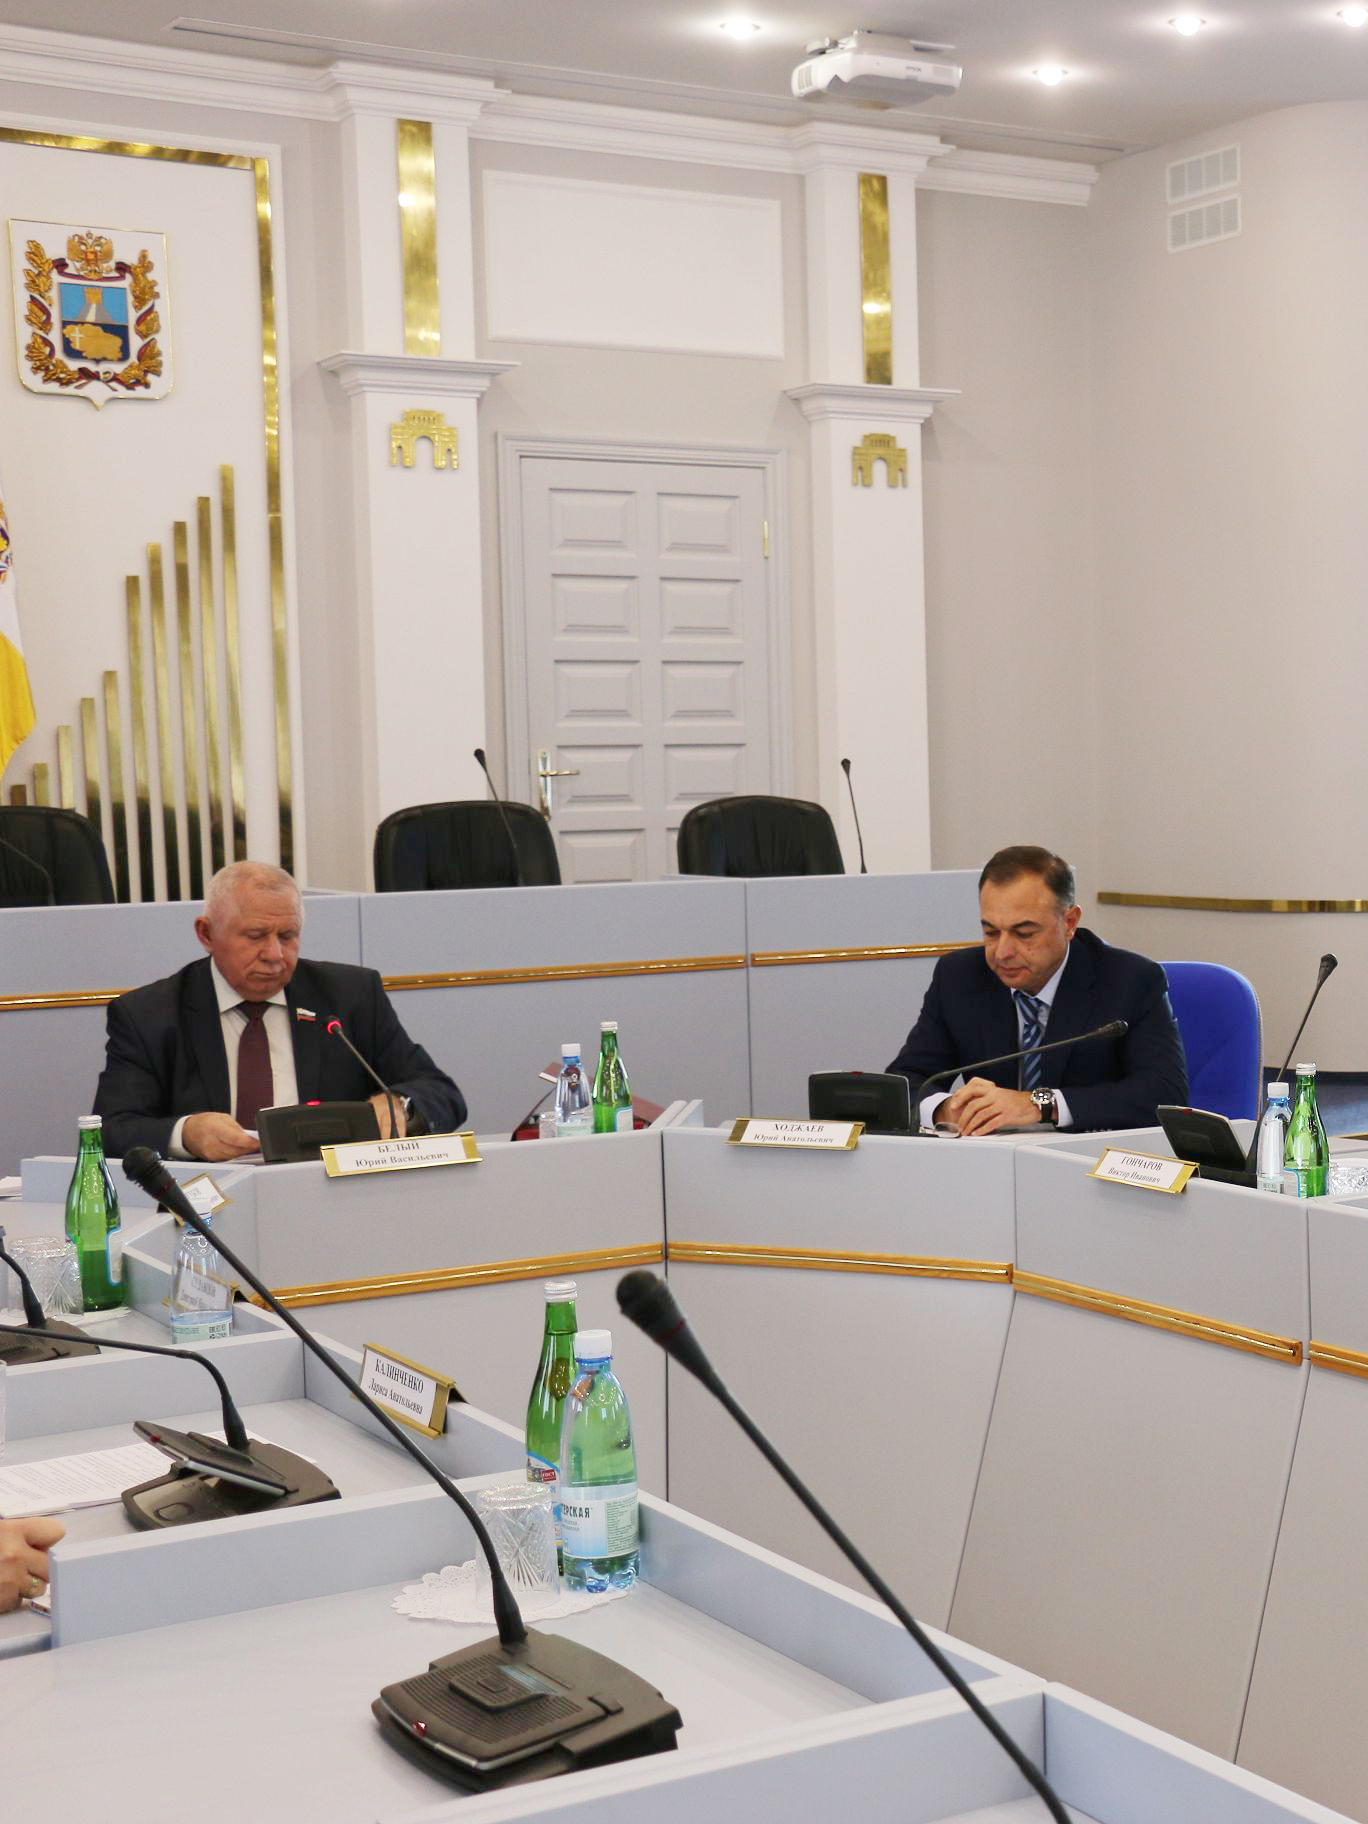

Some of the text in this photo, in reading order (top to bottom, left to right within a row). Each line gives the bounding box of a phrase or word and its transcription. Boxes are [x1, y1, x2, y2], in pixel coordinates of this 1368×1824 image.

[772, 1123, 825, 1133] ХОДЖАЕВ
[753, 1133, 834, 1144] Юрий Анатольевич
[377, 1140, 420, 1154] БЕЛЫЙ
[356, 1152, 449, 1168] Юрий Васильевич
[1120, 1156, 1163, 1171] ГОНЧАРОВ
[1107, 1166, 1161, 1184] Виктор Иванович
[375, 1358, 424, 1394] КАЛИНЧЕНКО
[368, 1377, 424, 1415] Лариса Анатольевна
